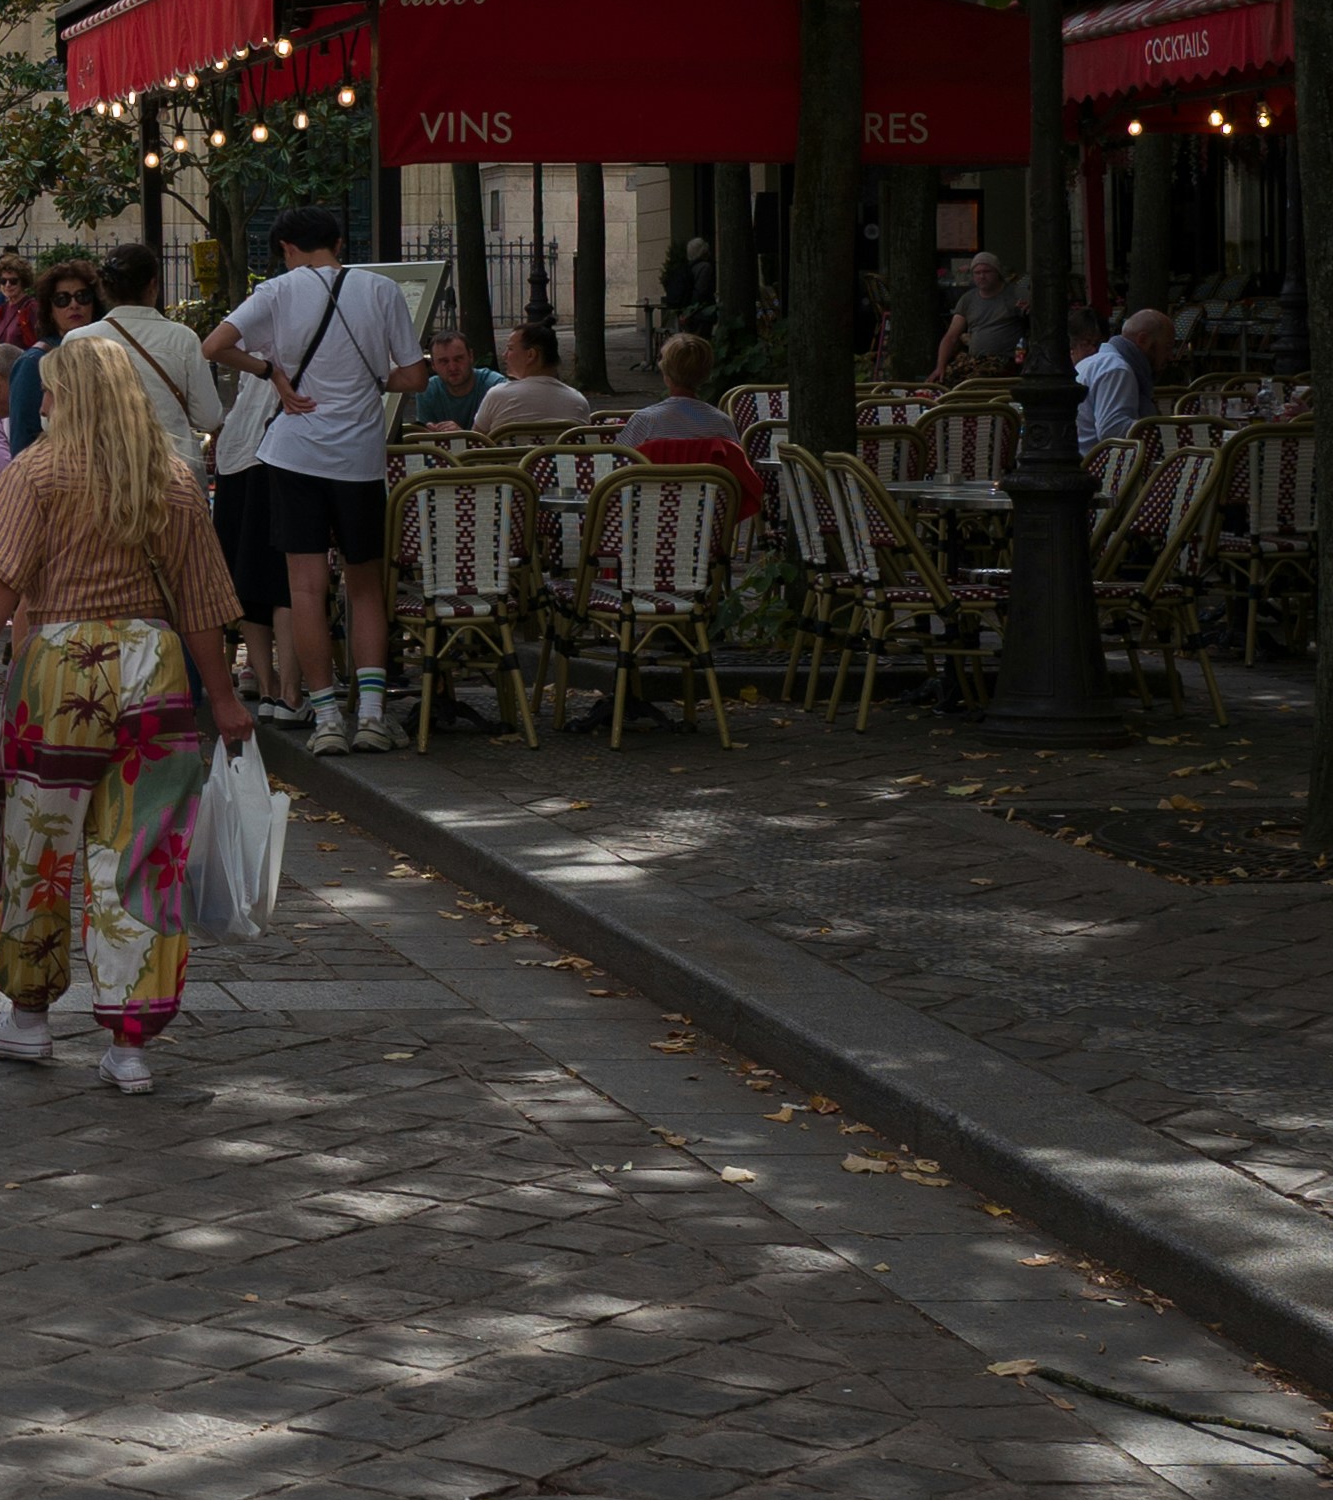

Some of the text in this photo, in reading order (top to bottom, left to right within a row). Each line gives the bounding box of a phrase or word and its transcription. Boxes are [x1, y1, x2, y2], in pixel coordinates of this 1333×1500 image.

[1145, 30, 1209, 65] COCKTAILS
[420, 111, 513, 144] VINS
[865, 112, 929, 144] RES
